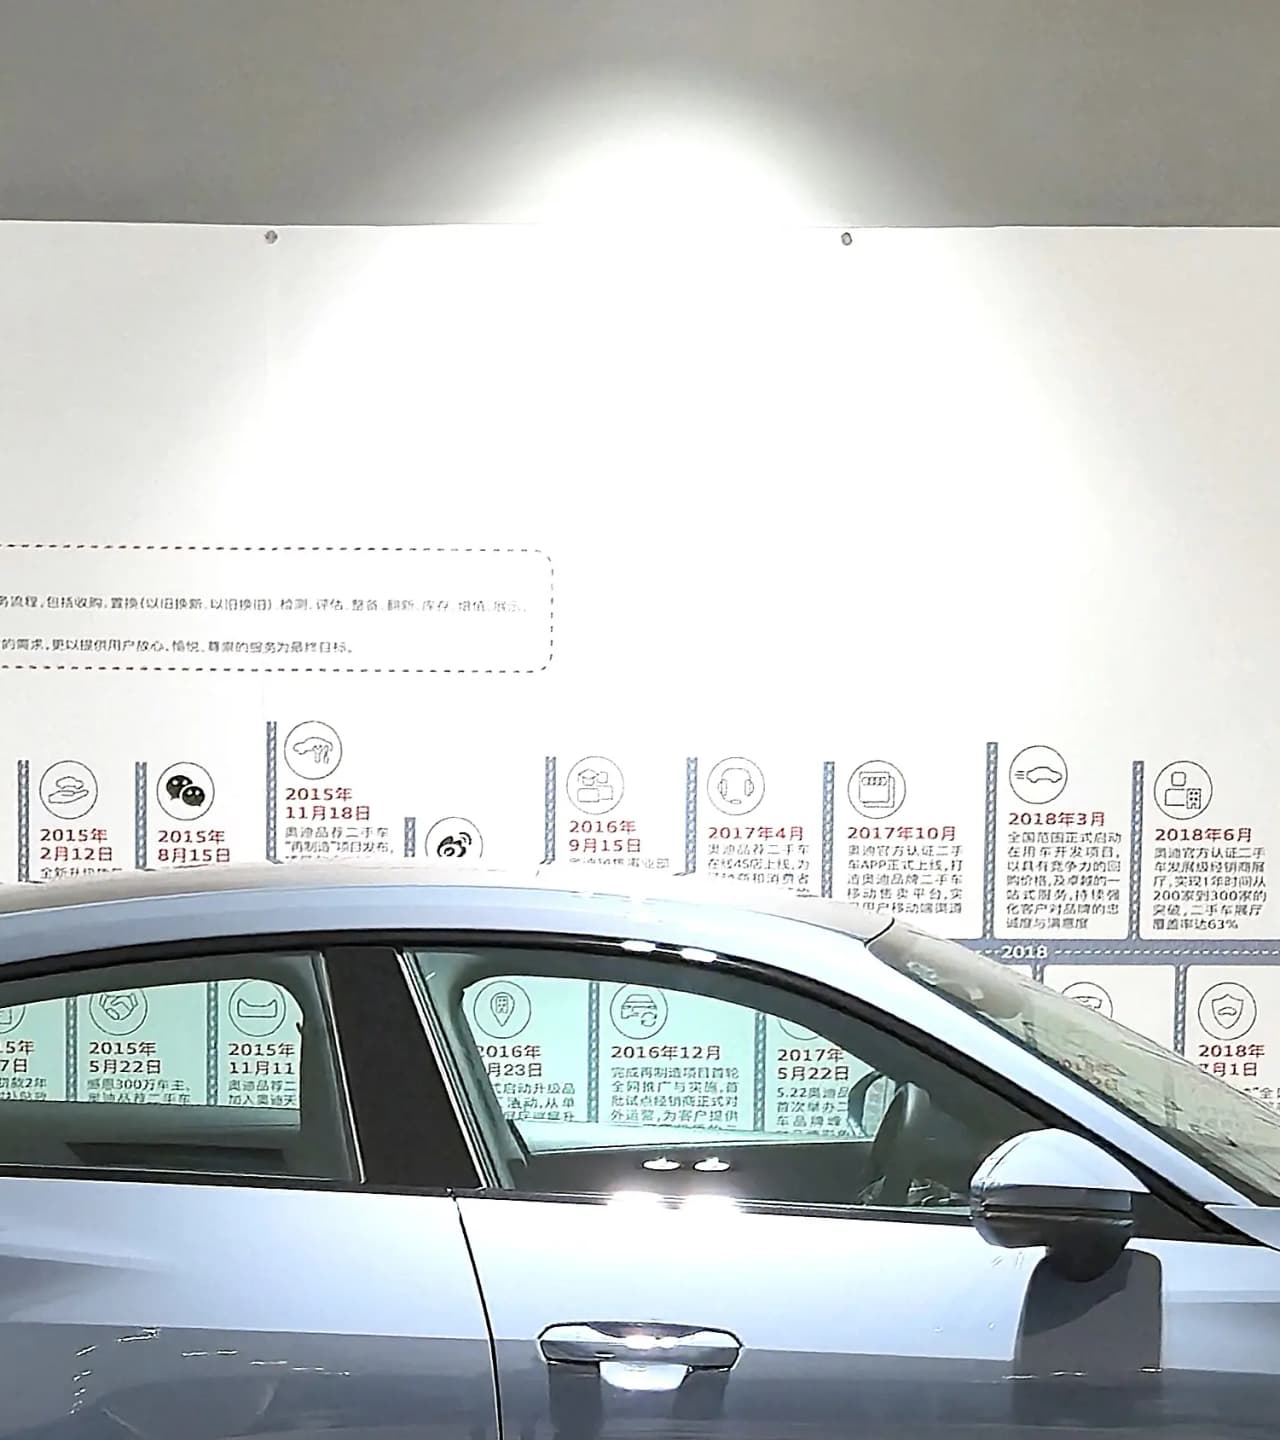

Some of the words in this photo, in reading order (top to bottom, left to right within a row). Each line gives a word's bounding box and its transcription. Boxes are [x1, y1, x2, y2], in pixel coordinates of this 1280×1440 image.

[285, 787, 353, 802] 2015年
[285, 805, 371, 821] 11月18日
[1008, 812, 1105, 827] 2018年3月
[569, 820, 637, 835] 2016年
[708, 826, 804, 841] 2017年4月
[847, 826, 956, 842] 2017年10月
[40, 828, 108, 843] 2015年
[158, 829, 225, 845] 2015年
[1008, 831, 1122, 843] 全国范围正式启动
[1154, 828, 1253, 843] 2018年6月
[569, 838, 641, 853] 9月15日
[40, 846, 113, 862] 2月12日
[158, 848, 231, 863] 8月15日
[1006, 918, 1089, 930] 诚度与满意度
[1000, 945, 1048, 959] 2018
[88, 1041, 157, 1057] 2015年
[228, 1043, 295, 1057] 2015年
[477, 1044, 542, 1060] 2016年
[610, 1044, 721, 1061] 2016年12月
[777, 1048, 845, 1063] 2017年
[1198, 1044, 1266, 1059] 2018年
[88, 1059, 162, 1075] 5月22日
[777, 1066, 850, 1081] 5月22日
